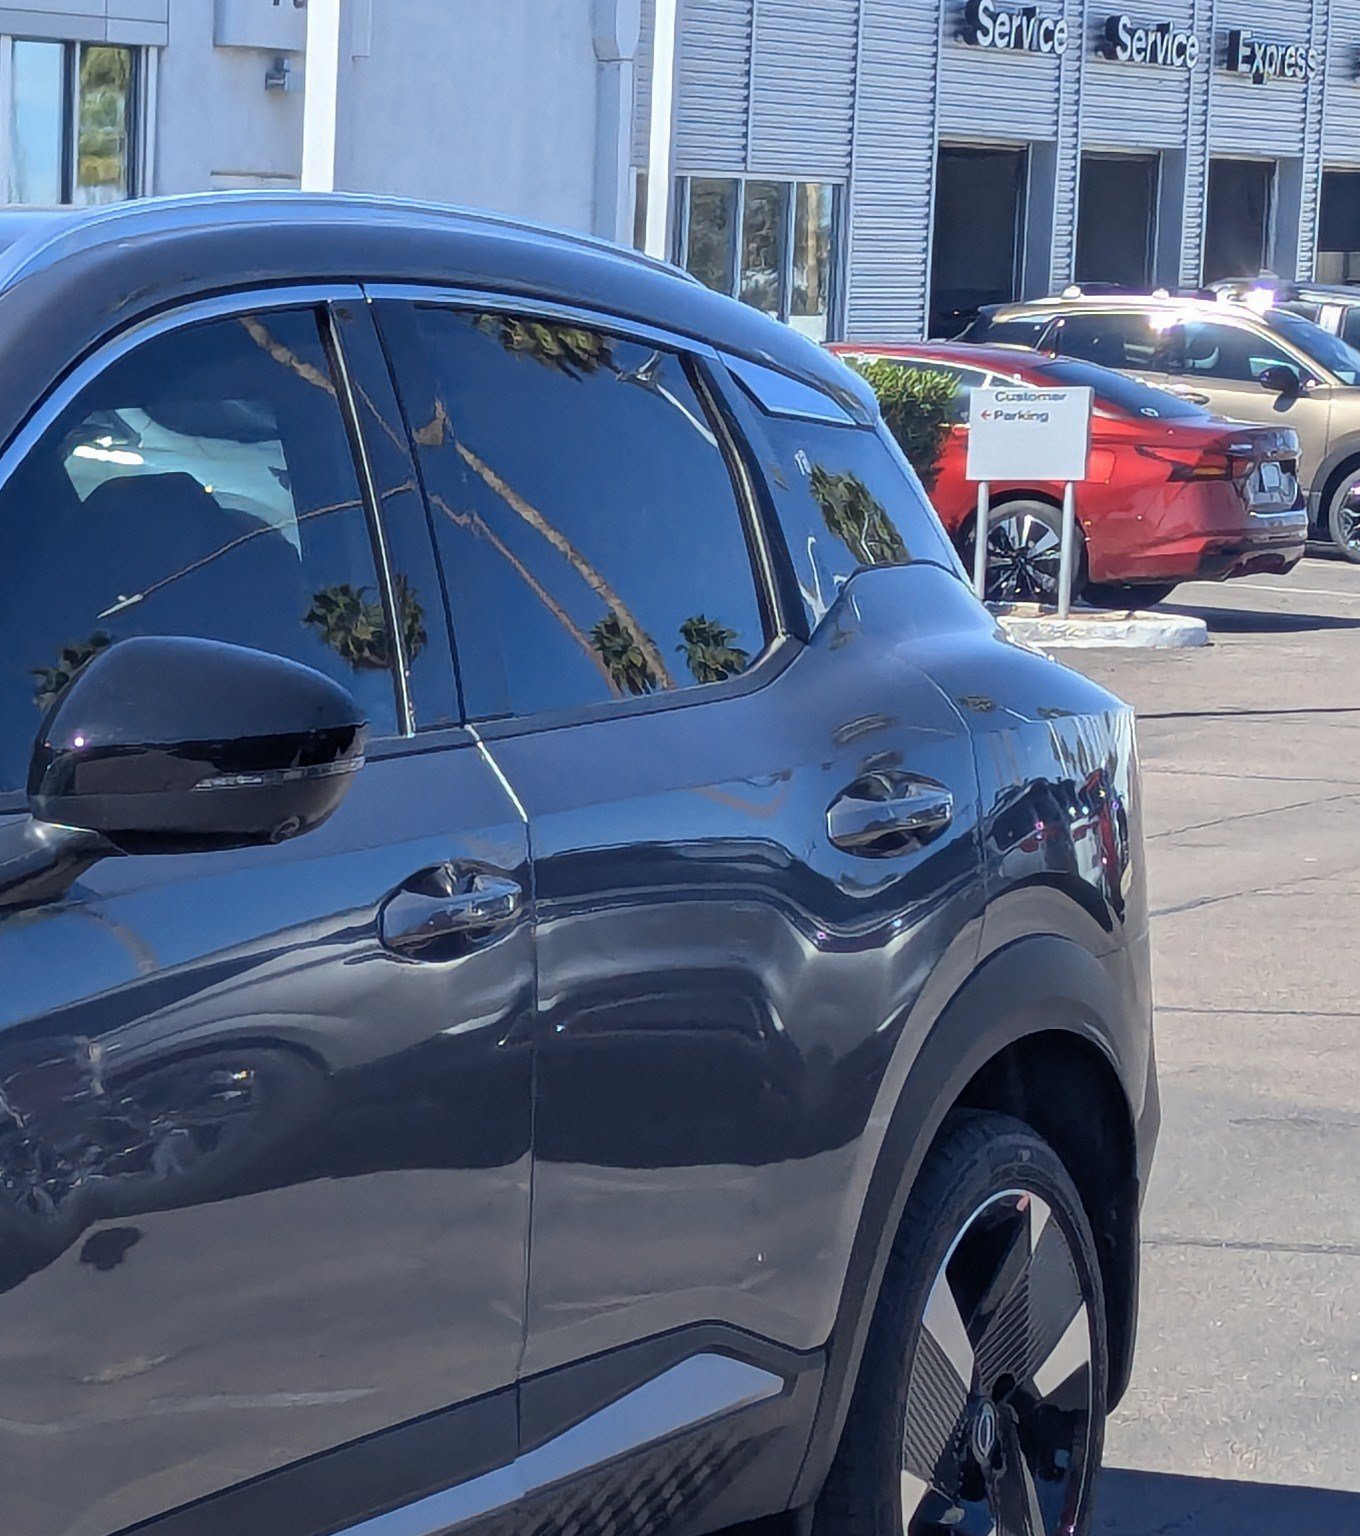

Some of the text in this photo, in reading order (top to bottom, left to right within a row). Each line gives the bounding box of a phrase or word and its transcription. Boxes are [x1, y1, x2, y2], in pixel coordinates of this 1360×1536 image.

[977, 0, 1068, 54] Service
[1117, 15, 1199, 68] Service
[1237, 29, 1317, 85] Express
[993, 409, 1050, 423] Parking
[994, 391, 1067, 403] Customer
